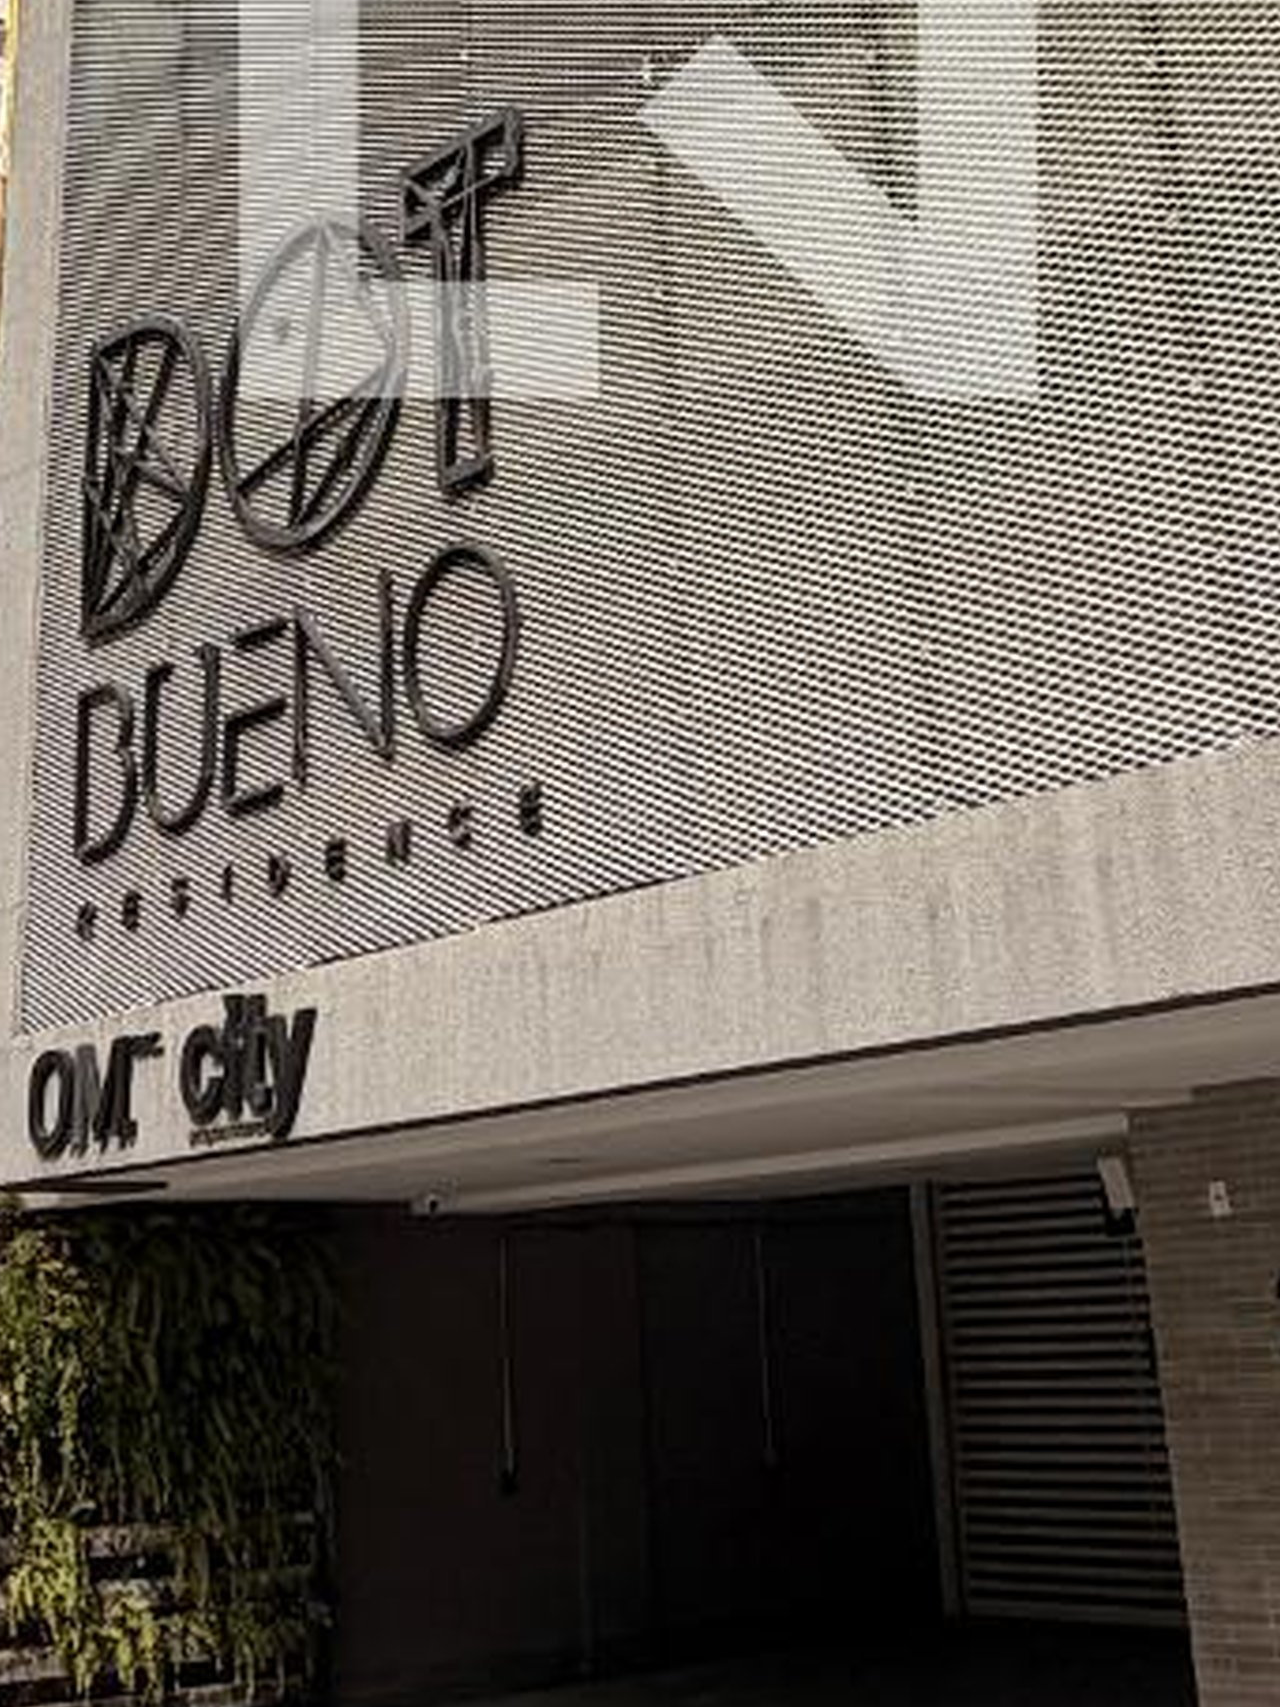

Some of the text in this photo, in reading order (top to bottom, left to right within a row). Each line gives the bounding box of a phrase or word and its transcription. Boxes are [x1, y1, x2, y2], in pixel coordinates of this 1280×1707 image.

[80, 104, 522, 640] DOT
[70, 541, 520, 865] BUENO
[76, 782, 546, 942] RESIDENCE
[178, 992, 319, 1142] city
